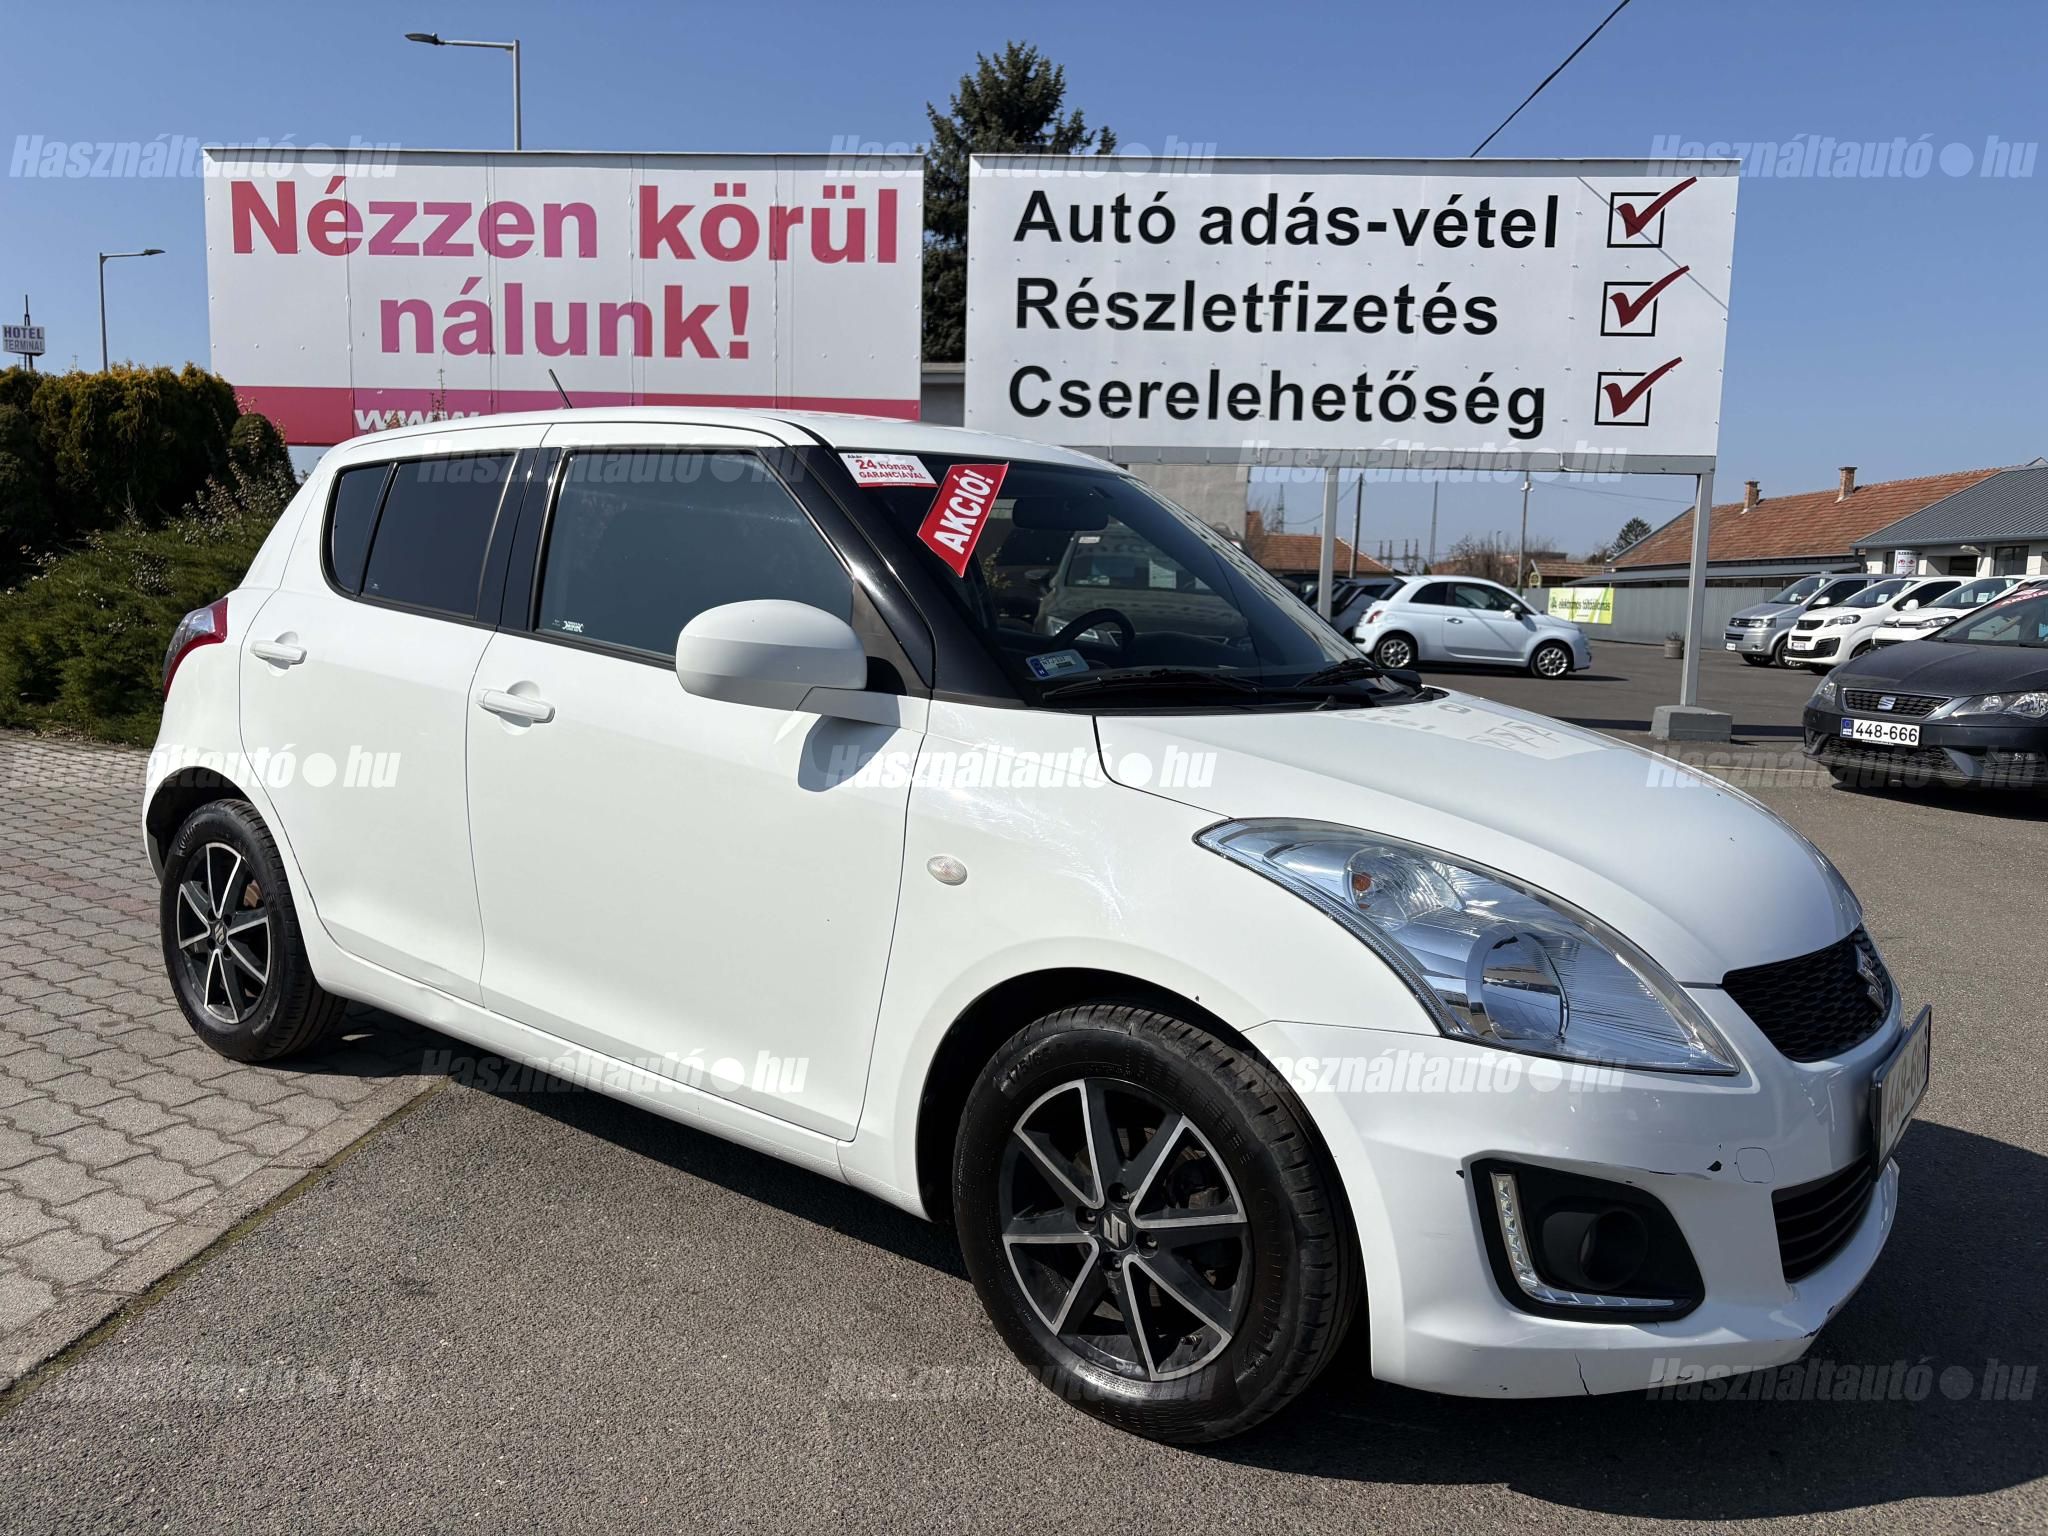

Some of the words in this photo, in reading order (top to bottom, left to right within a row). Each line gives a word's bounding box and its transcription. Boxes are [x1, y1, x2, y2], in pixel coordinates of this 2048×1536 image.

[232, 176, 596, 258] Nézzen
[640, 182, 897, 263] körül
[1015, 191, 1175, 244] Autó
[1200, 192, 1557, 248] adás-vétel
[4, 327, 44, 340] HOTEL
[381, 276, 748, 359] nálunk!
[1018, 278, 1497, 335] Részletfizetés
[4, 339, 44, 351] TERMINAL
[1010, 366, 1544, 439] Cserelehetőség
[855, 459, 877, 470] 24
[933, 469, 994, 555] AKCIÓ!
[1855, 721, 1918, 743] 448-666
